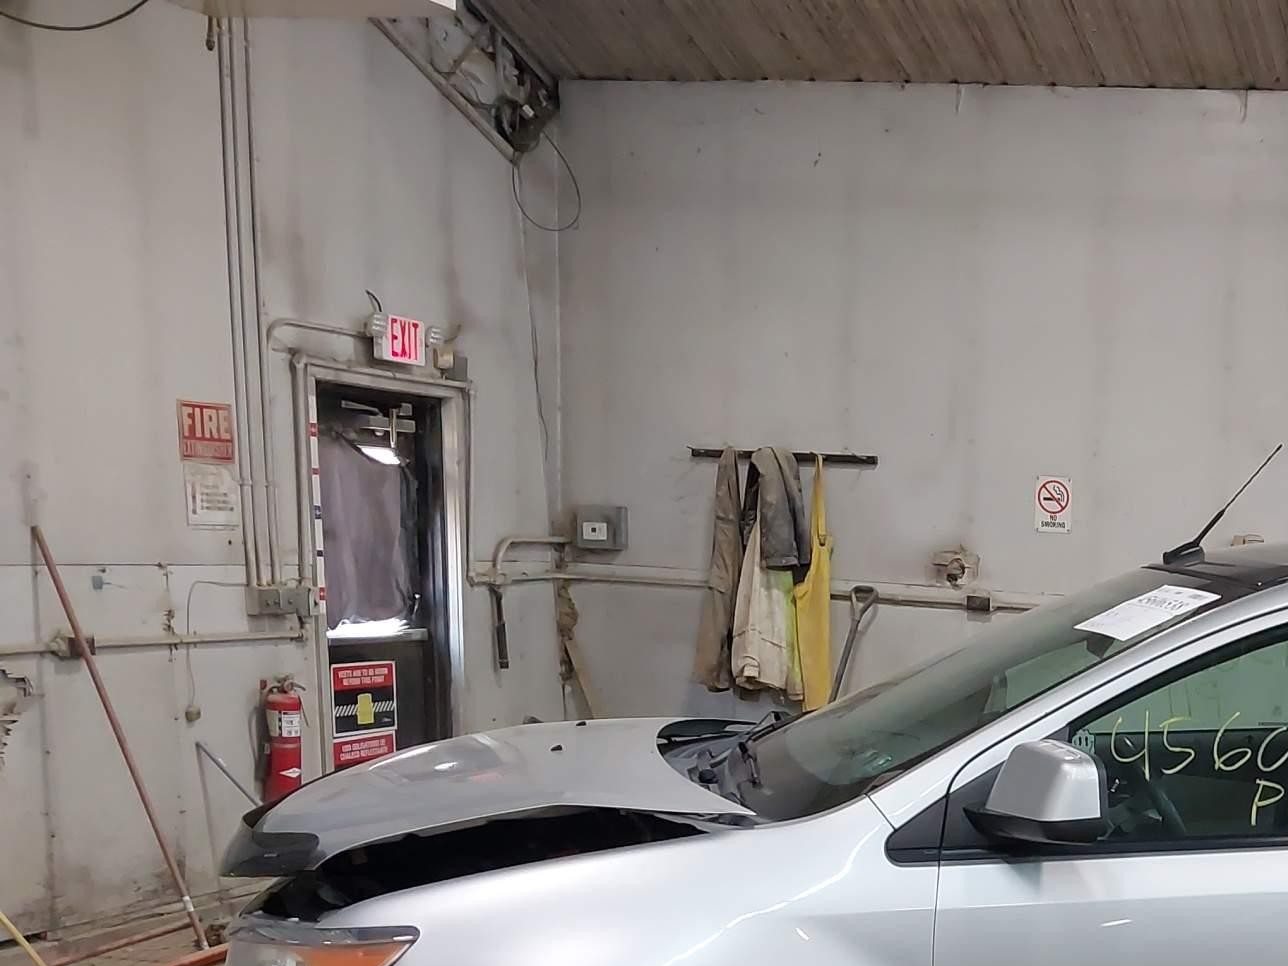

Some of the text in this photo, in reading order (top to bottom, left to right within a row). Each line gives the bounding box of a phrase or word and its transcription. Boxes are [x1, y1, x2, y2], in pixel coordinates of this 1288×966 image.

[391, 318, 419, 361] EXIT
[181, 406, 232, 439] FIRE
[1040, 520, 1066, 528] SMOKING
